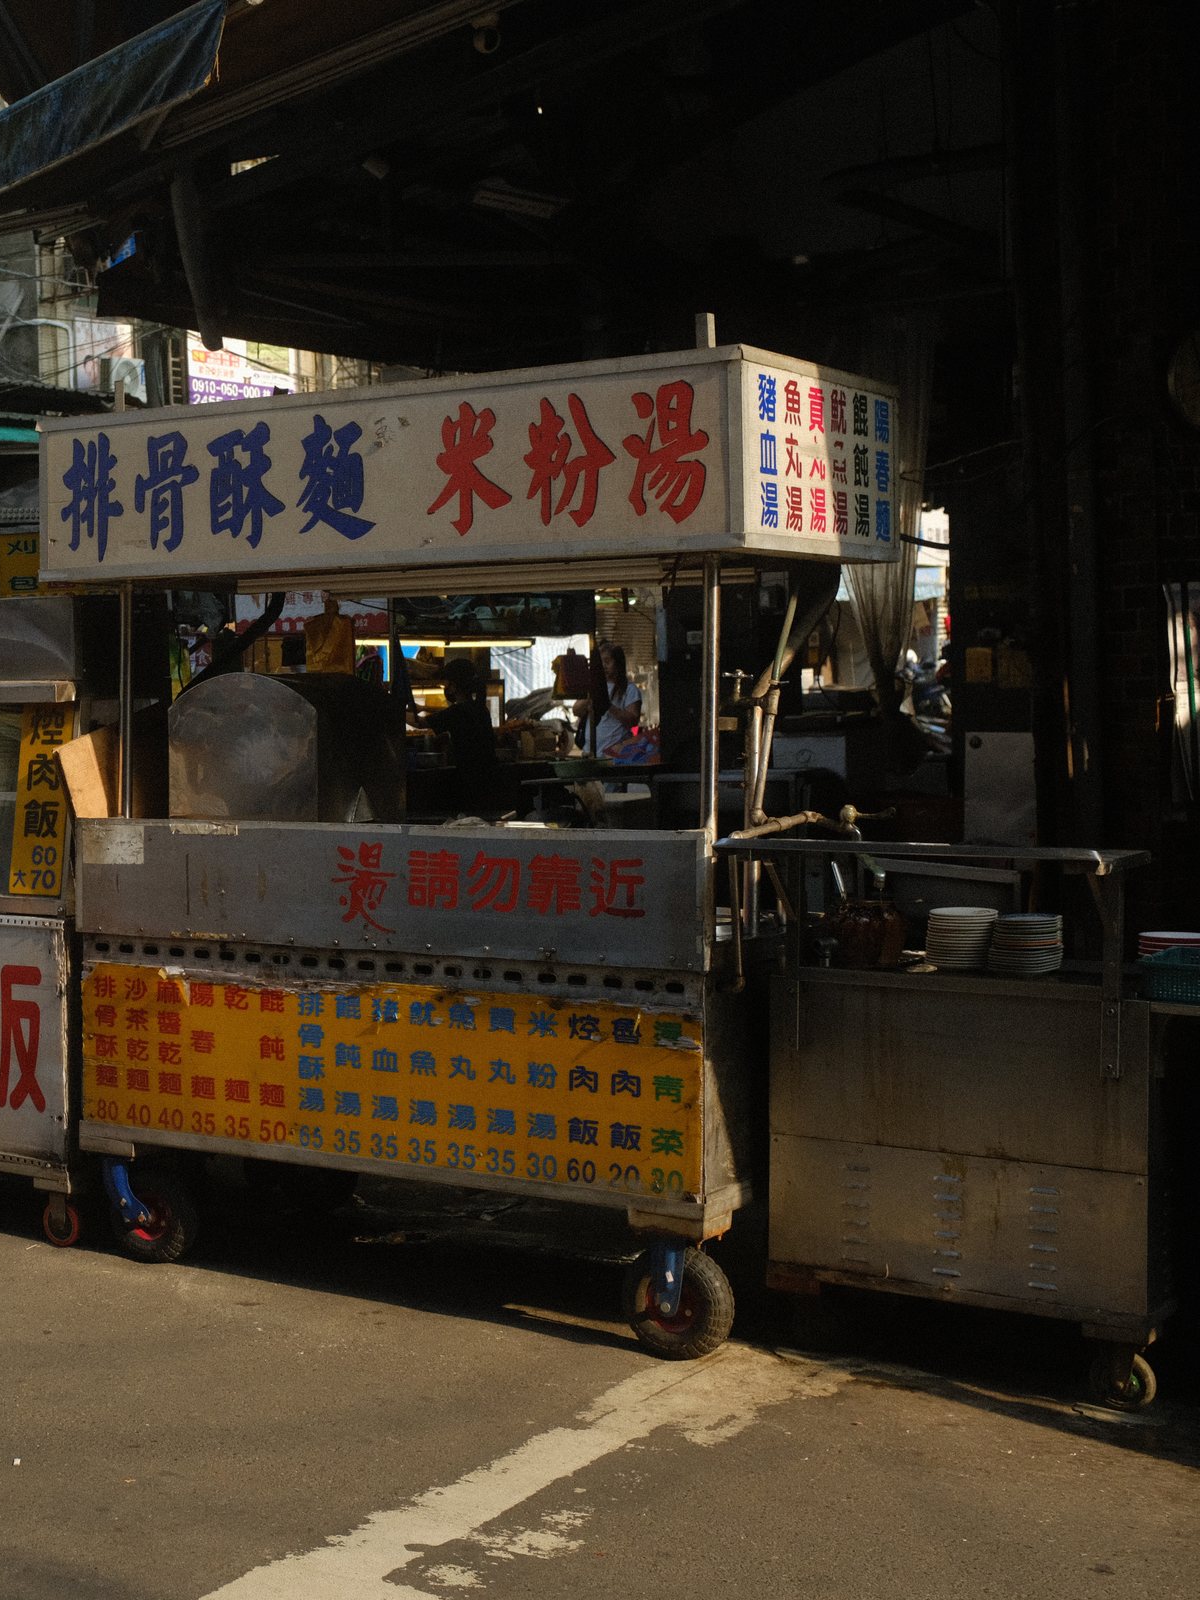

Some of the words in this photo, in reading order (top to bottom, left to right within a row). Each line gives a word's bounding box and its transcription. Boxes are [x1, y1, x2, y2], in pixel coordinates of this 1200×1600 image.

[758, 373, 779, 529] 豬血湯
[784, 379, 803, 532] 魚丸湯
[60, 413, 377, 564] 排骨酥麵
[426, 379, 710, 537] 米粉湯
[874, 399, 891, 543] 陽春麵
[7, 538, 38, 591] 刈包
[31, 845, 57, 867] 60
[93, 975, 119, 1089] 排骨酥麵
[125, 976, 150, 1093] 沙茶乾麵
[189, 982, 216, 1101] 陽春麵
[296, 992, 326, 1113] 排骨酥湯
[447, 1003, 477, 1131] 魚丸湯
[487, 1007, 517, 1135] 貢丸湯
[527, 1011, 558, 1141] 米粉湯
[609, 1017, 642, 1151] 魯肉飯
[97, 1099, 119, 1121] 80
[126, 1103, 152, 1126] 40
[158, 1108, 184, 1130] 40
[191, 1111, 216, 1135] 35
[224, 1115, 251, 1140] 35
[259, 1119, 287, 1143] 50
[299, 1124, 324, 1149] 65
[333, 1128, 362, 1154] 35
[370, 1134, 399, 1159] 35
[407, 1138, 438, 1164] 35
[447, 1143, 477, 1169] 35
[486, 1148, 517, 1174] 35
[526, 1153, 558, 1181] 30
[567, 1159, 597, 1184] 60
